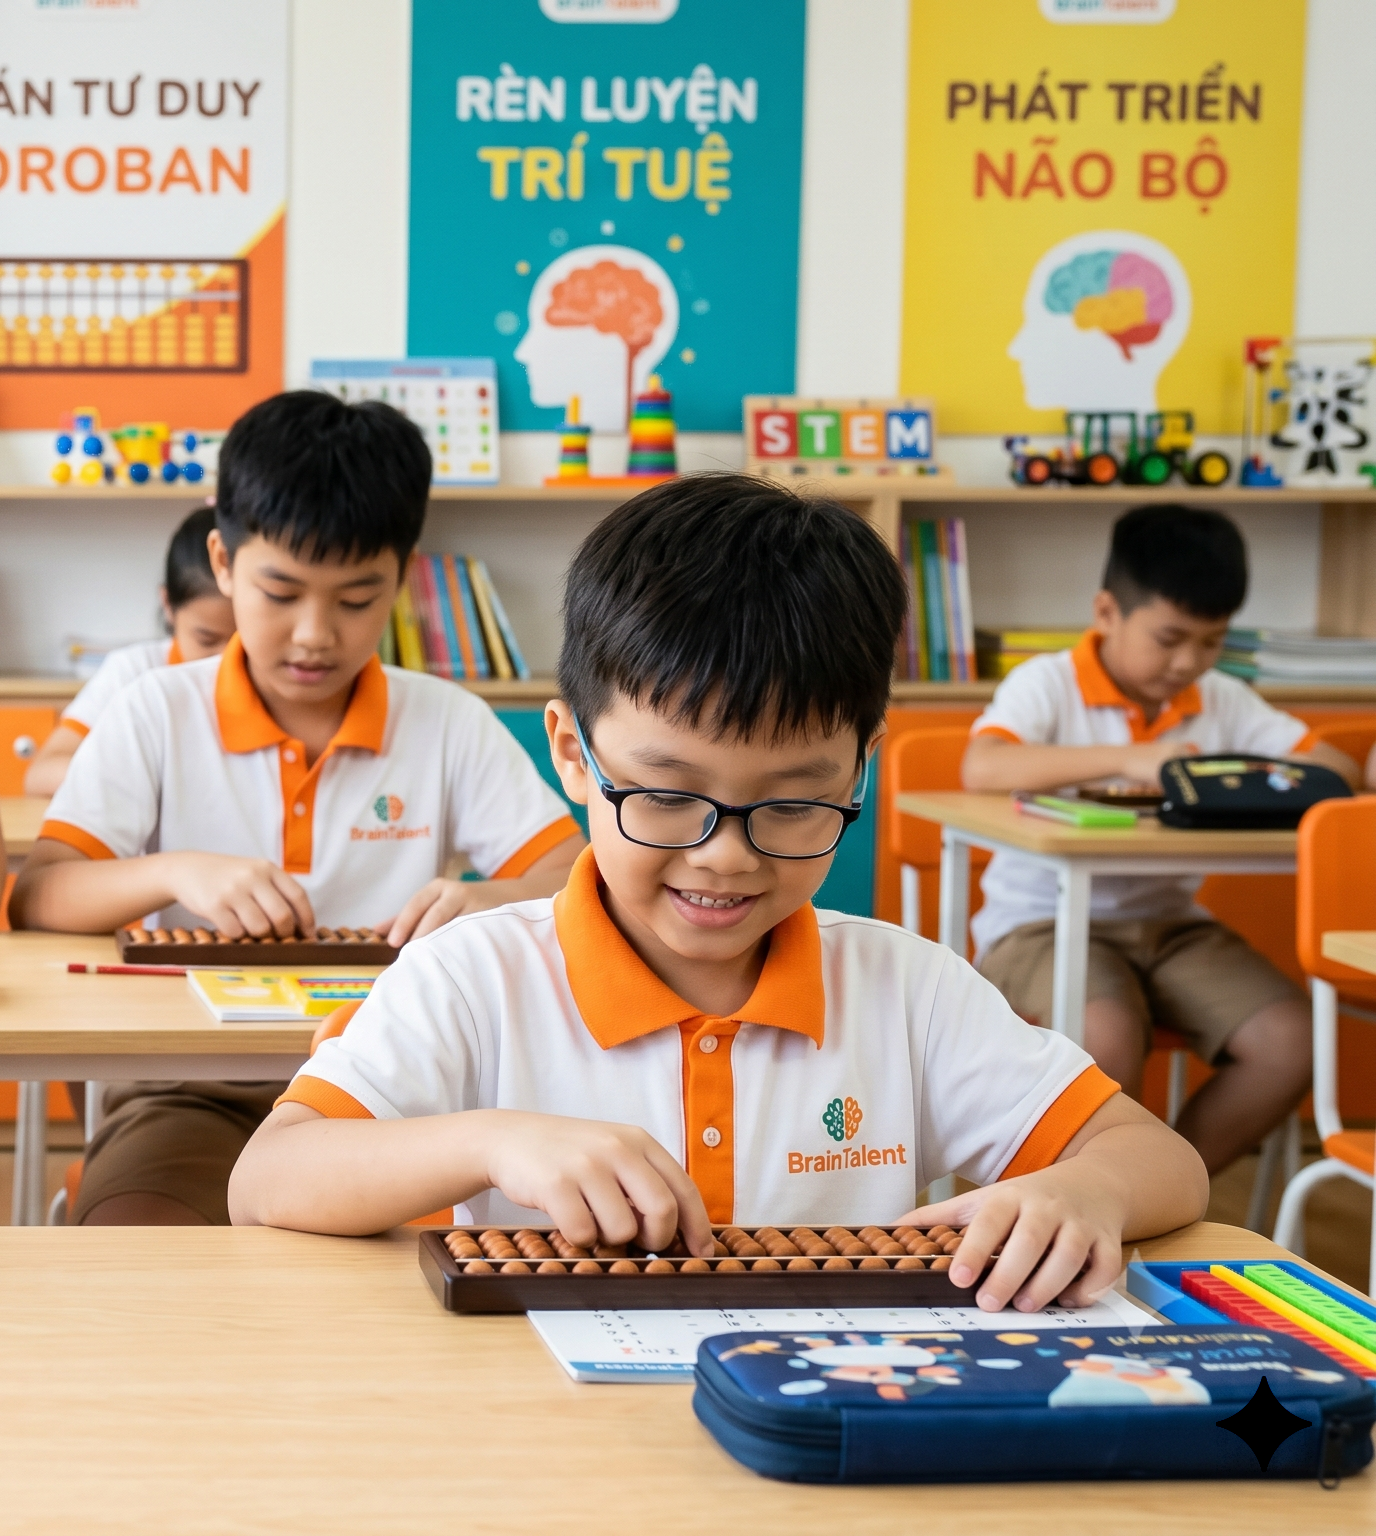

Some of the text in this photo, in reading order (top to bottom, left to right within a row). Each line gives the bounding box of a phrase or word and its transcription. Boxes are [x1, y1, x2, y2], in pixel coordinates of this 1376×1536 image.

[73, 74, 143, 117] TƯ
[158, 80, 261, 118] DUY
[456, 62, 758, 135] RÈN LUYỆN
[946, 61, 1262, 123] PHÁT TRIỂN
[477, 130, 733, 216] TRÍ TUỆ
[974, 134, 1229, 215] NÃO BỘ
[760, 414, 928, 455] STEM
[788, 1144, 907, 1174] BrainTalent
